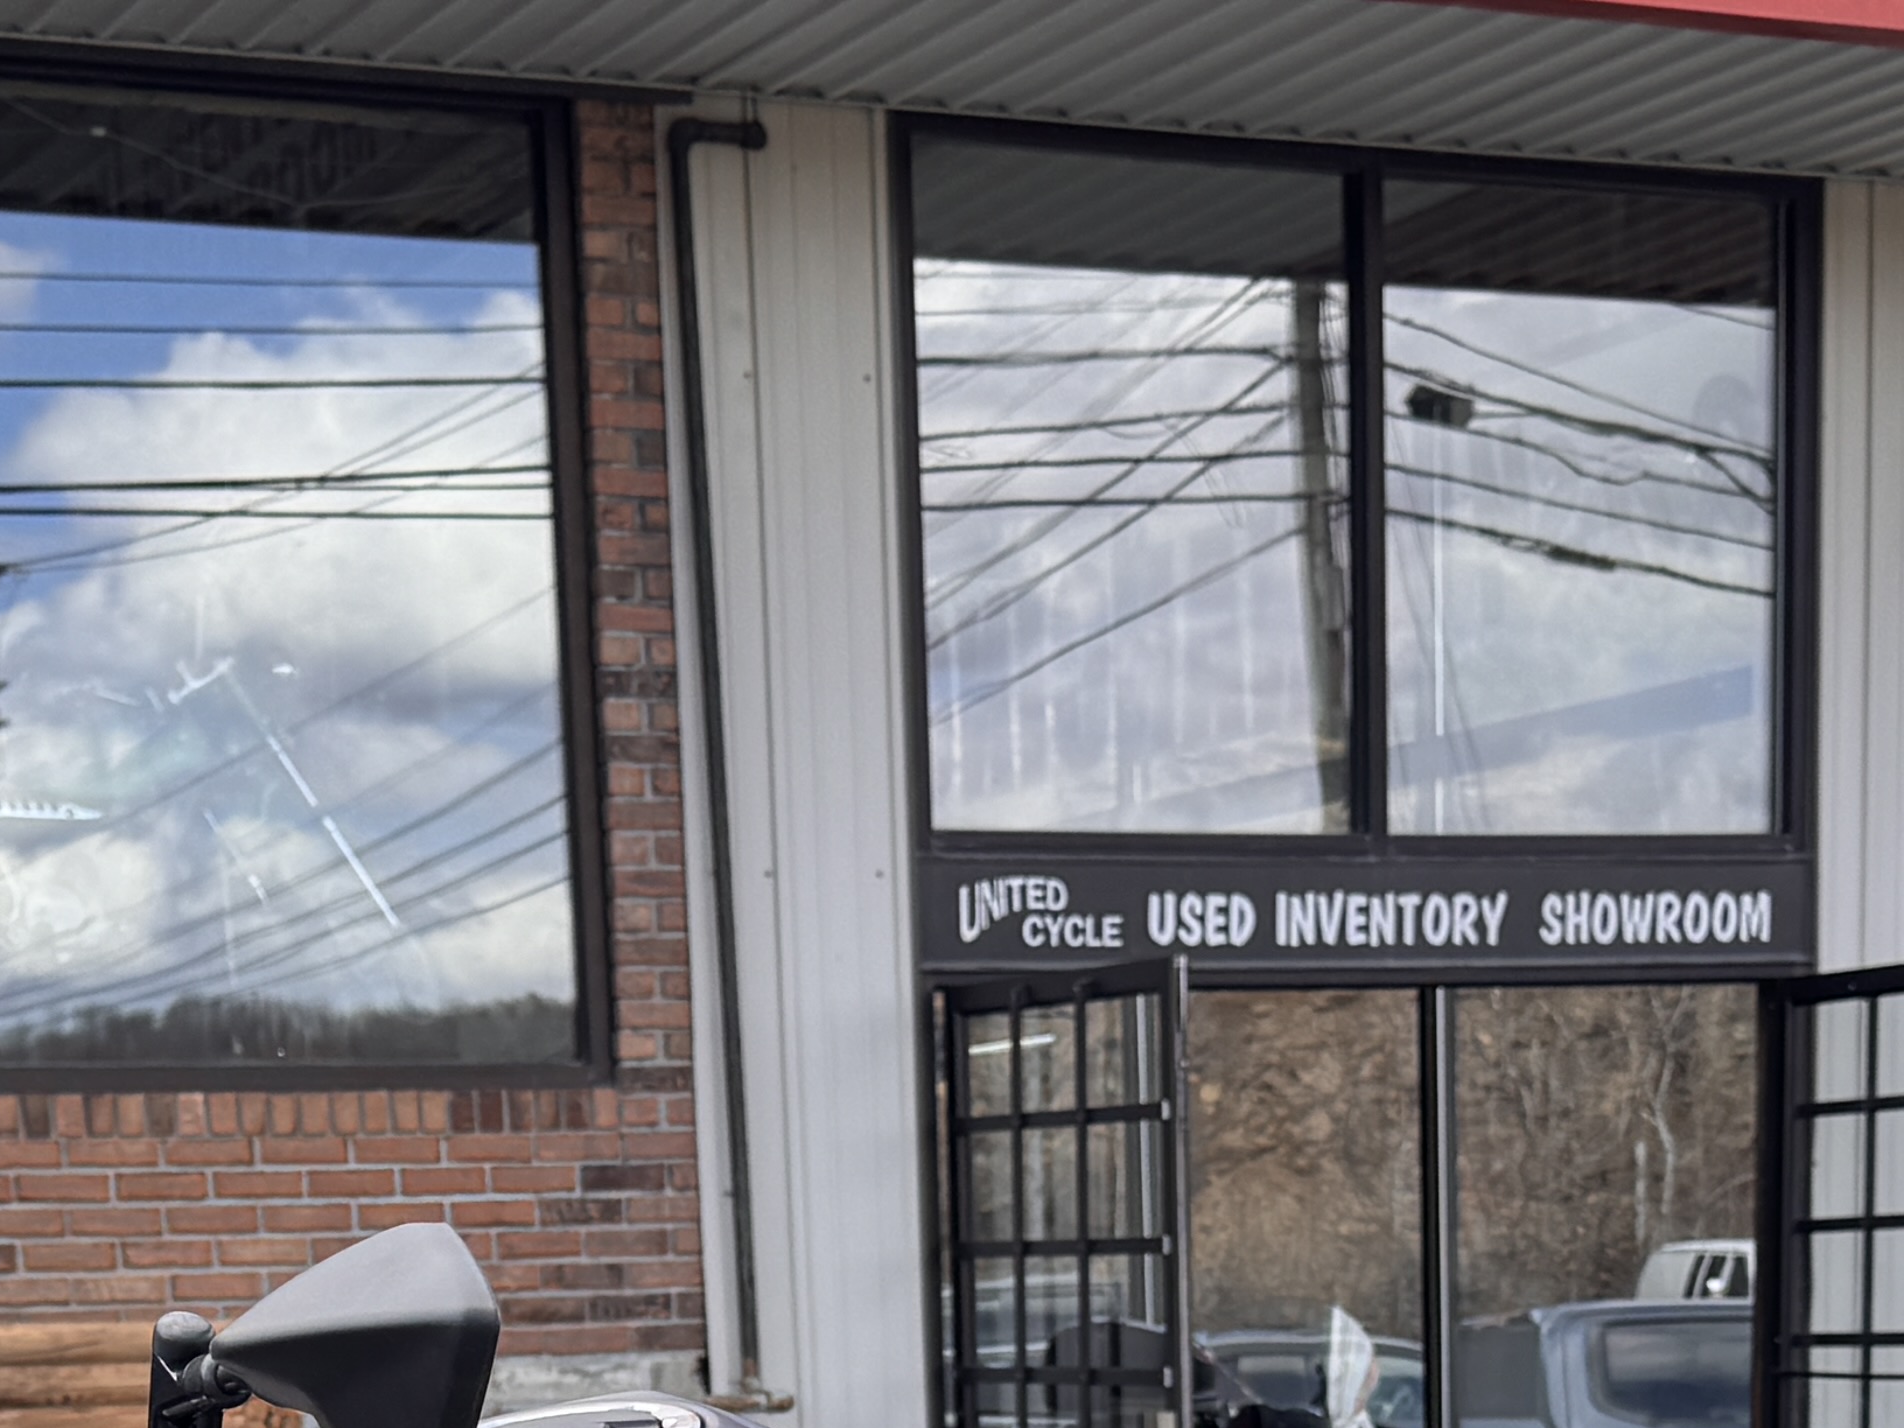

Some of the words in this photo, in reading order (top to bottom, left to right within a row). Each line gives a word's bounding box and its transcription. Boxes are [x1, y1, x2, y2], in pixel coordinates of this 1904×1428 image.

[958, 875, 1069, 943] UNITED
[1022, 914, 1123, 948] CYCLE
[1147, 891, 1255, 947] USED
[1275, 890, 1510, 947] INVENTORY
[1539, 890, 1773, 945] SHOWROOM
